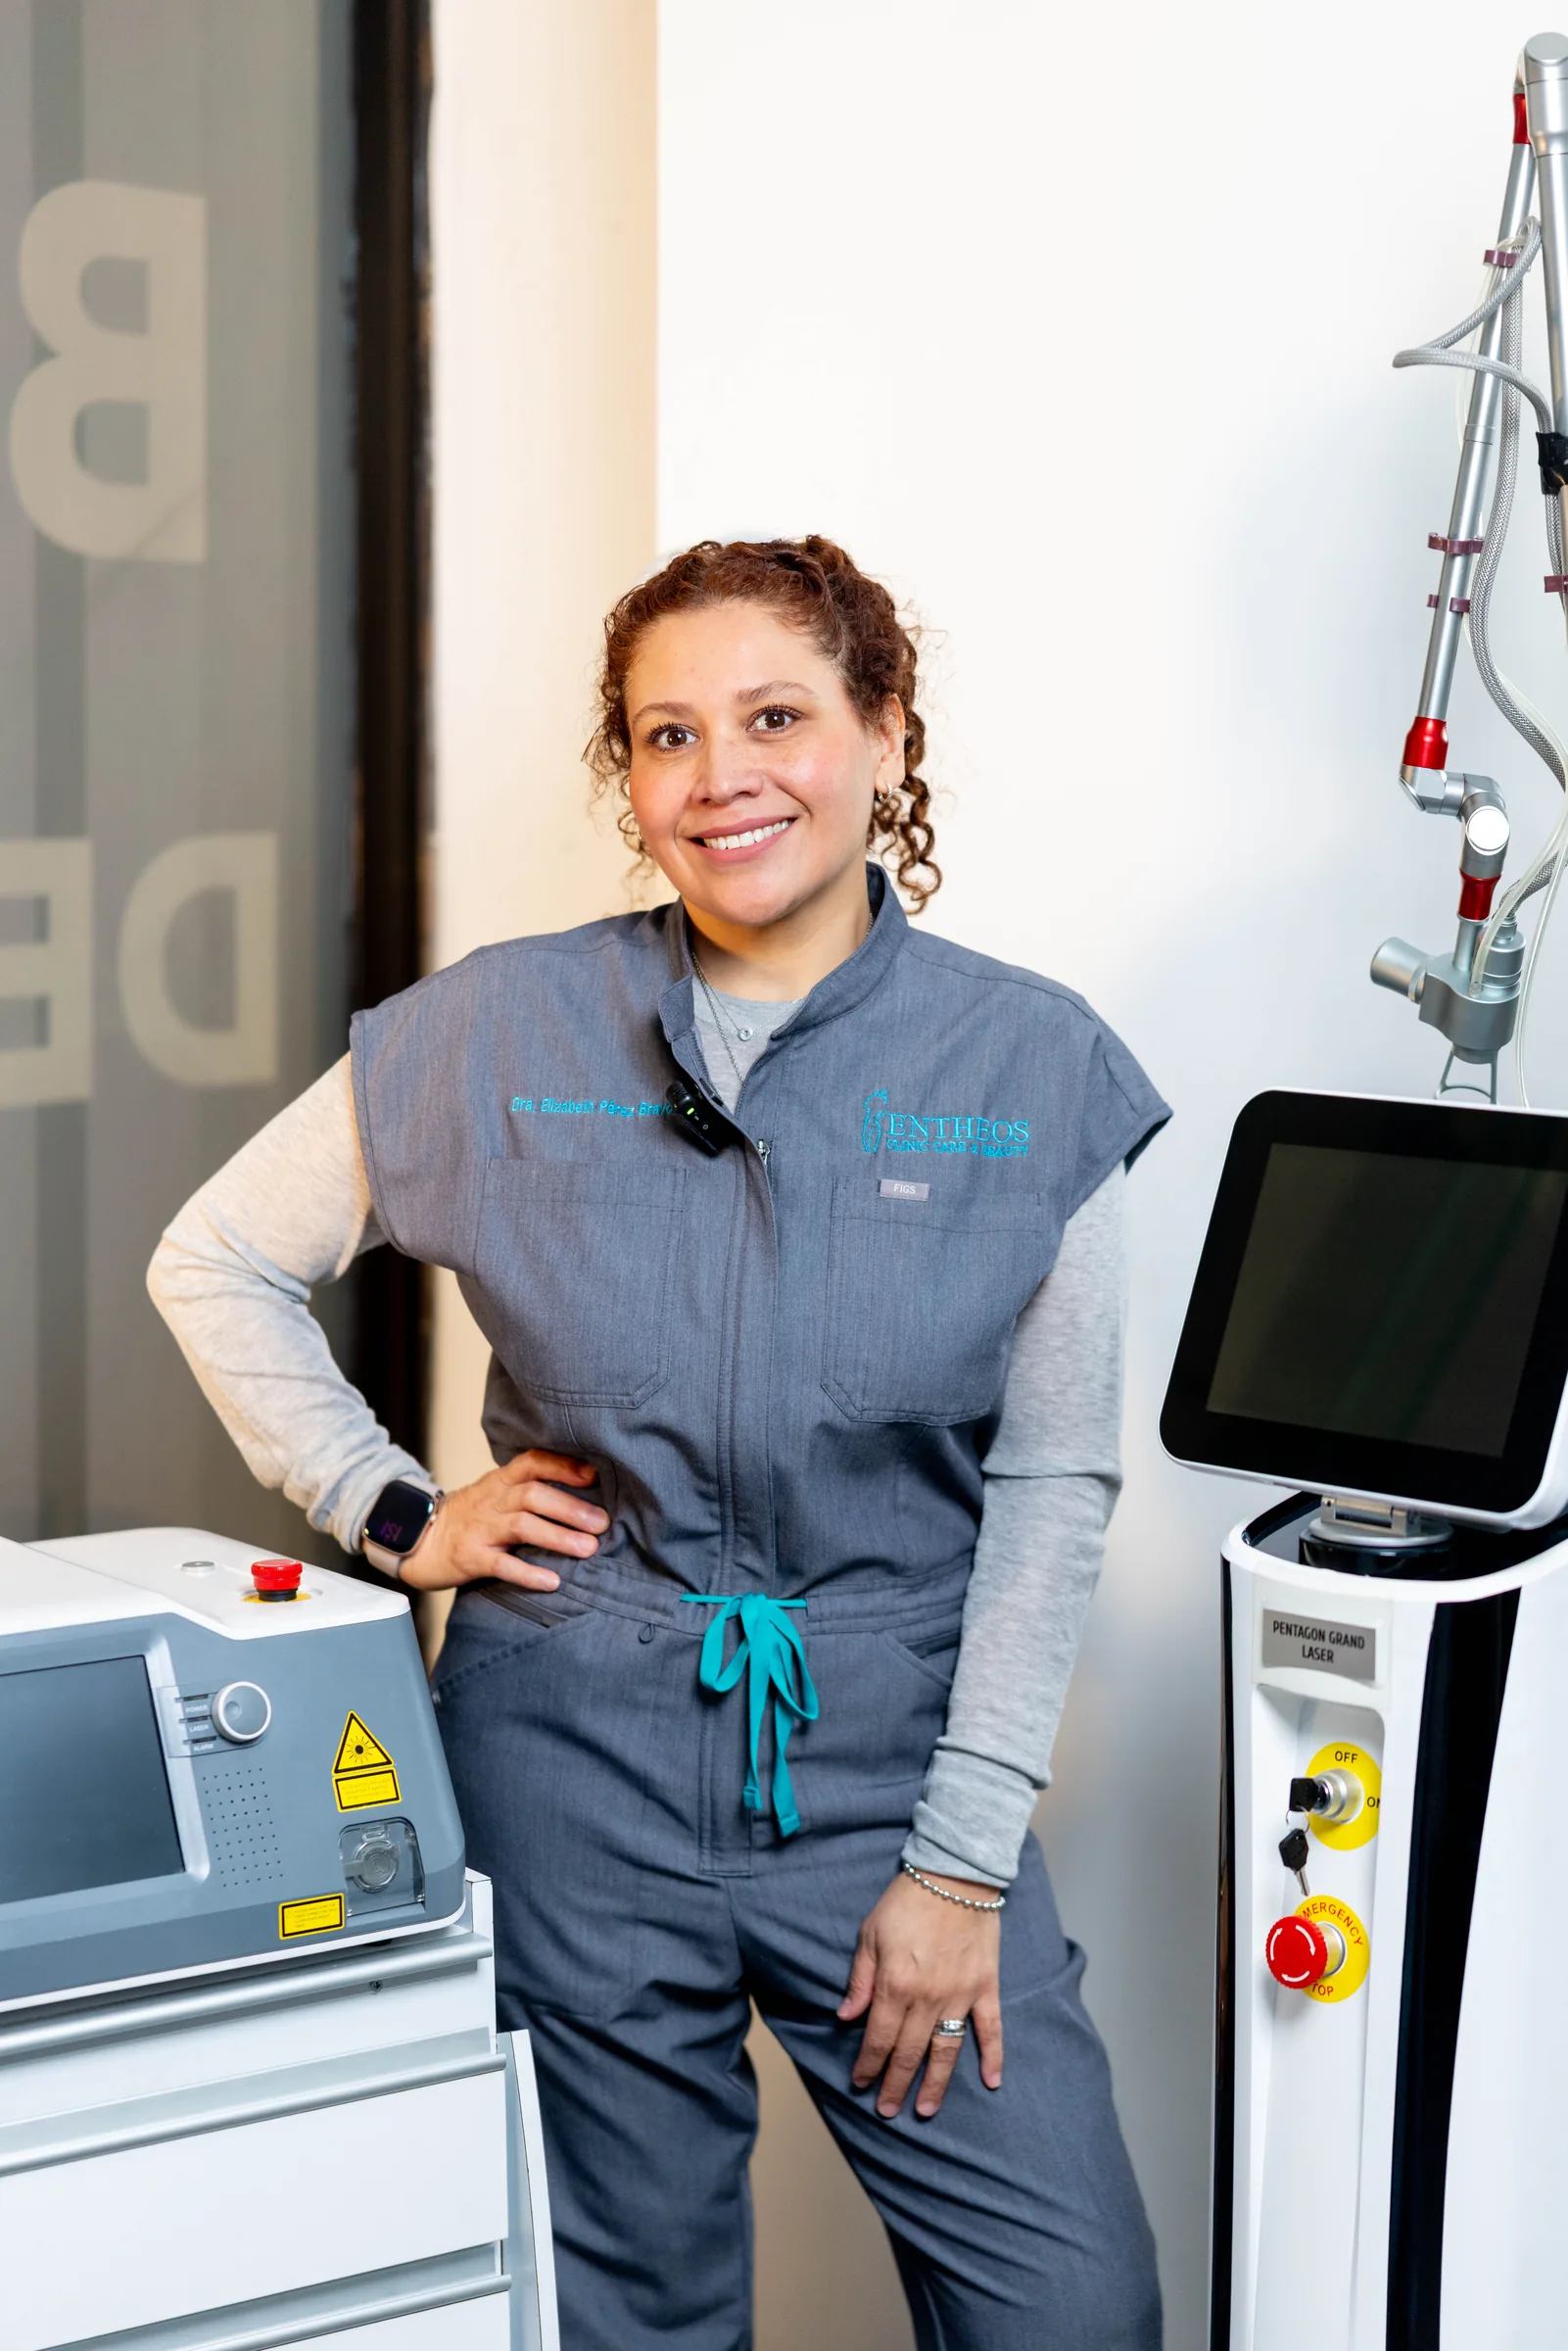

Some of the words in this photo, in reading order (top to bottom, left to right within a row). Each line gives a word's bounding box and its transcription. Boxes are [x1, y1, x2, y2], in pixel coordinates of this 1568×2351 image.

[511, 1096, 535, 1111] Dra.
[541, 1097, 594, 1113] Elizabeth
[887, 1113, 1029, 1143] ENTHEOS
[886, 1139, 928, 1152] CLINIC
[932, 1141, 967, 1153] CARE
[971, 1143, 979, 1155] &
[982, 1144, 1029, 1157] BEAUTY
[893, 1183, 916, 1194] FIGS
[1273, 1620, 1325, 1642] PENTAGON
[1329, 1631, 1364, 1650] GRAND
[1302, 1645, 1334, 1663] LASER
[1334, 1751, 1357, 1763] OFF
[1303, 1901, 1363, 1946] MERGENCY
[1311, 1983, 1334, 1997] TOP
